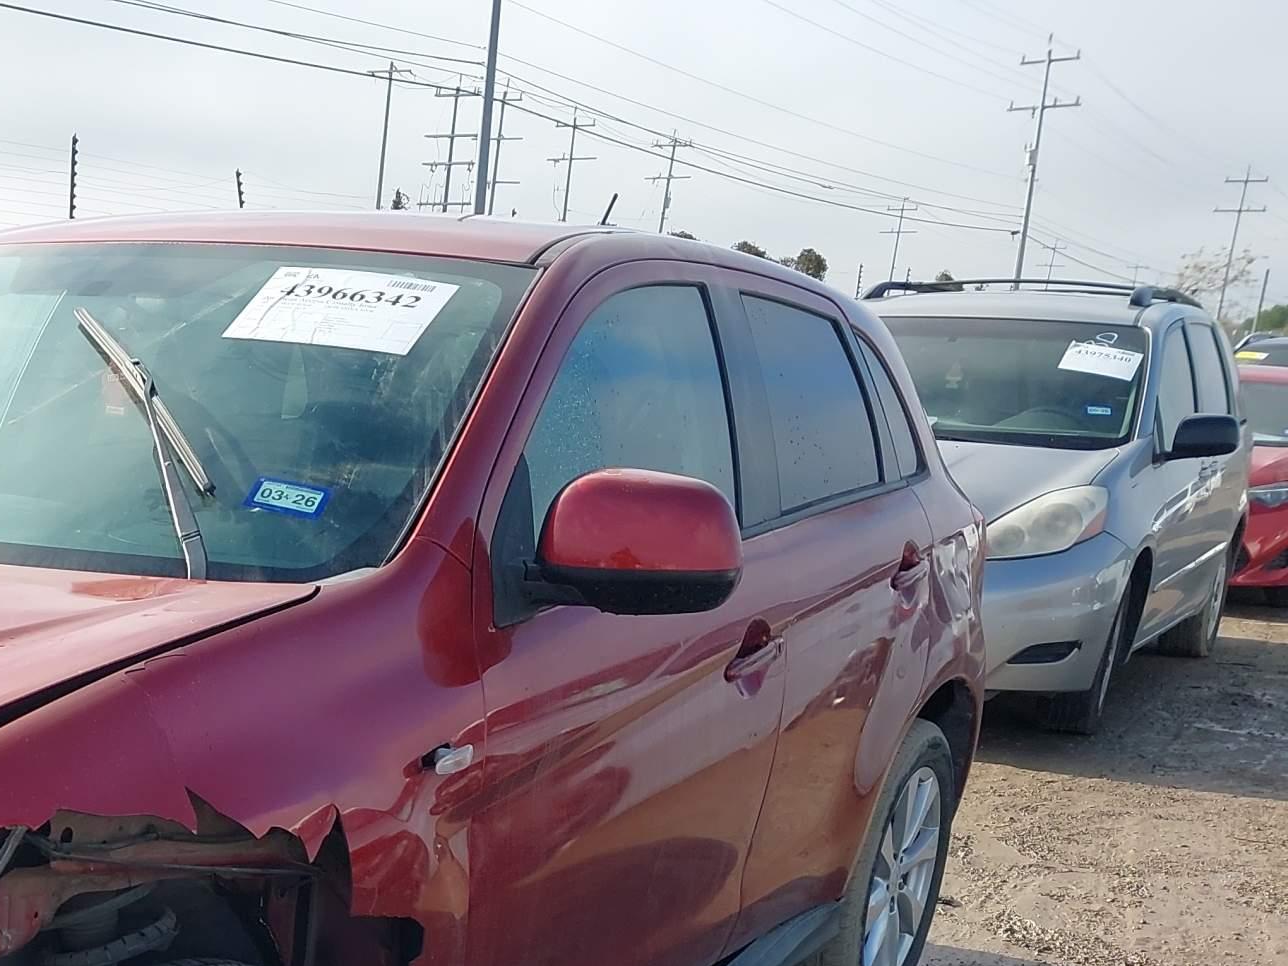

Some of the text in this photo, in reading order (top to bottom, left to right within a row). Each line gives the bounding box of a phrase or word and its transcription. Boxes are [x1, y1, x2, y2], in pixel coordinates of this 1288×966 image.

[280, 283, 422, 308] 43966342
[260, 488, 285, 501] 03
[291, 494, 318, 508] 26
